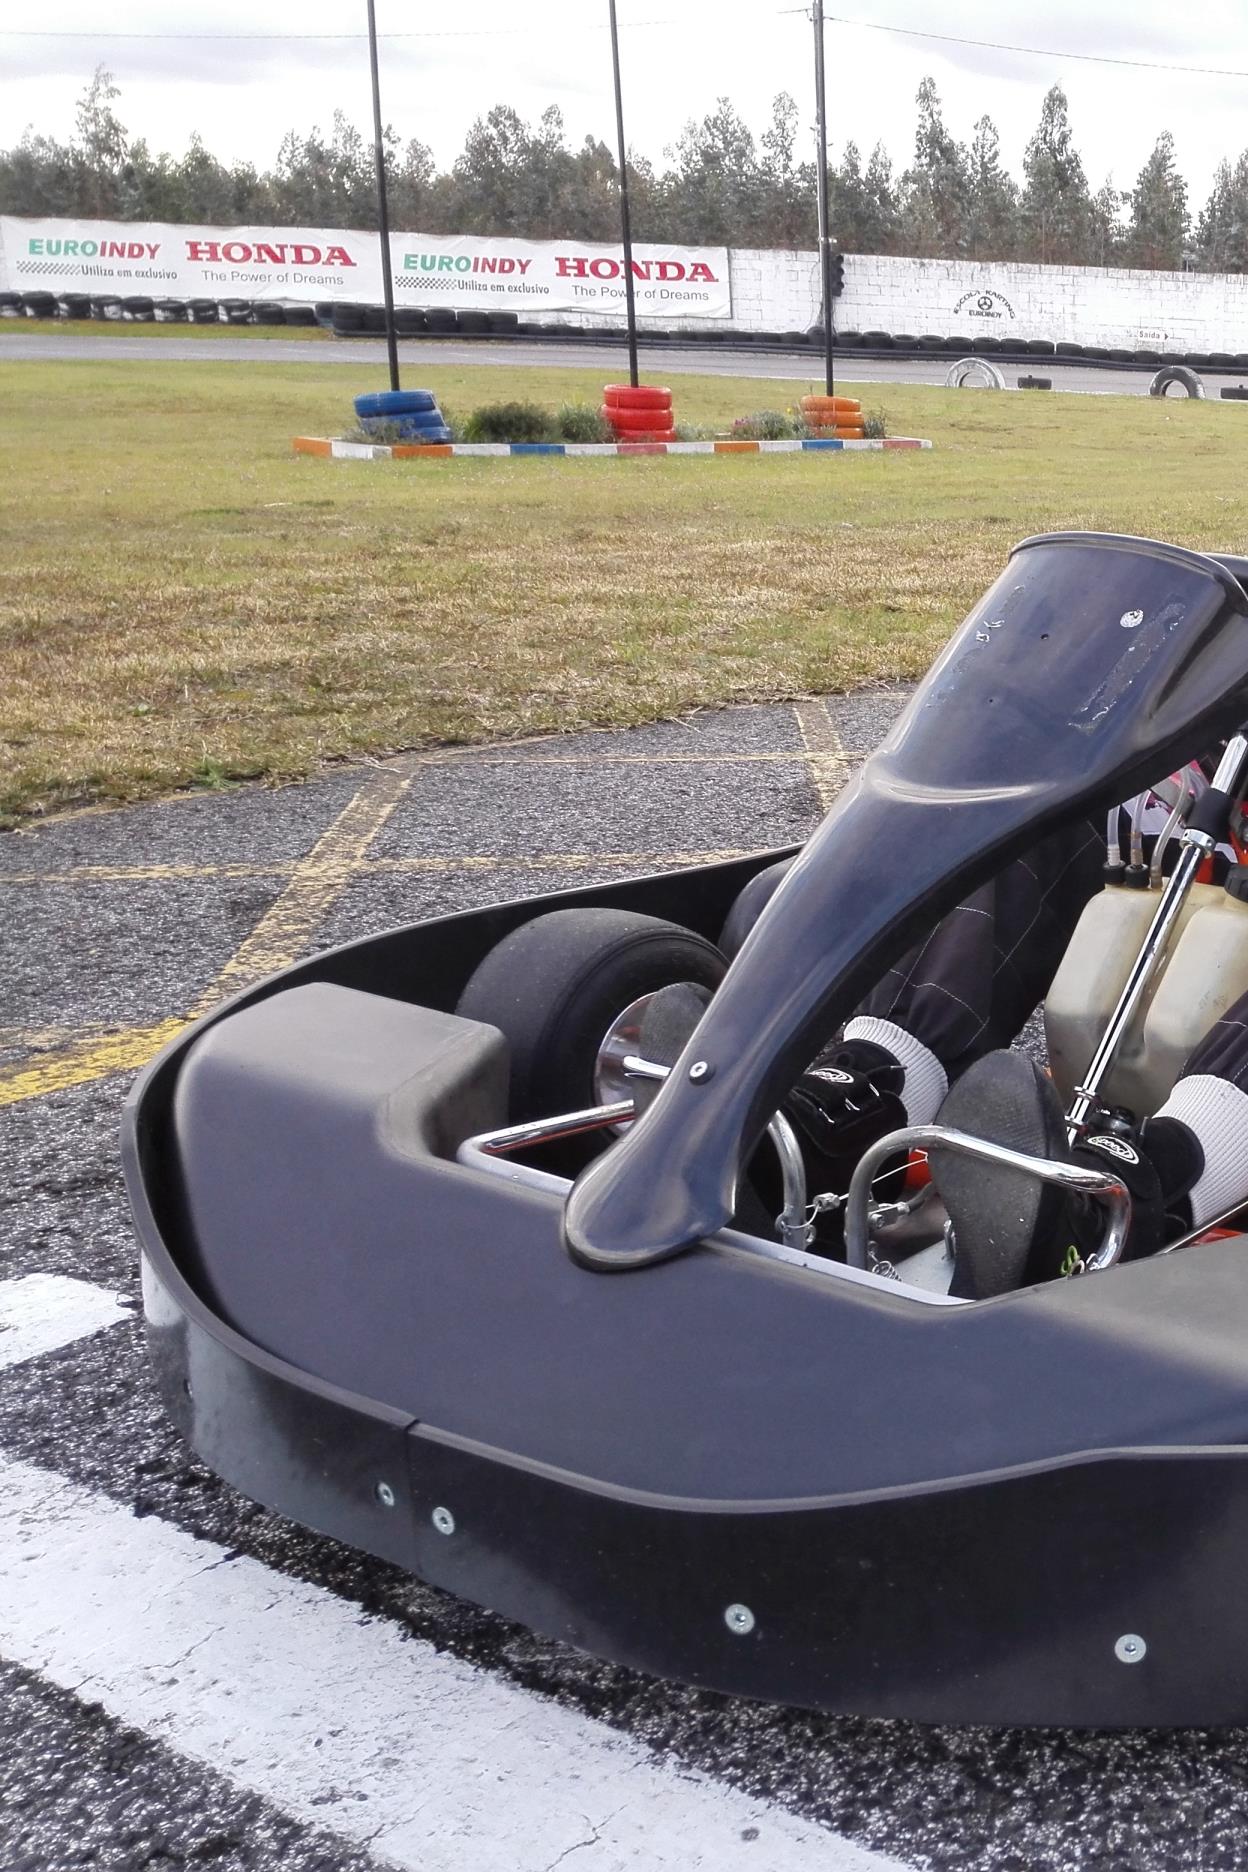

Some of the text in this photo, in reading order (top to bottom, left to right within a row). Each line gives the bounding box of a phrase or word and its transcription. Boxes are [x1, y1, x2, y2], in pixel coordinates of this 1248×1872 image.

[28, 238, 161, 260] EUROINDY
[185, 240, 357, 266] HONDA
[81, 264, 178, 281] Utiliza em exclusivo
[403, 253, 533, 275] EUROINDY
[555, 256, 719, 283] HONDA
[201, 270, 345, 286] The Power of Dreams
[458, 279, 550, 295] Utiliza em exclusivo
[571, 285, 709, 301] The Powr of Dreams
[953, 290, 1015, 319] ESCOLA KARTING
[968, 309, 1003, 319] EUROINDY
